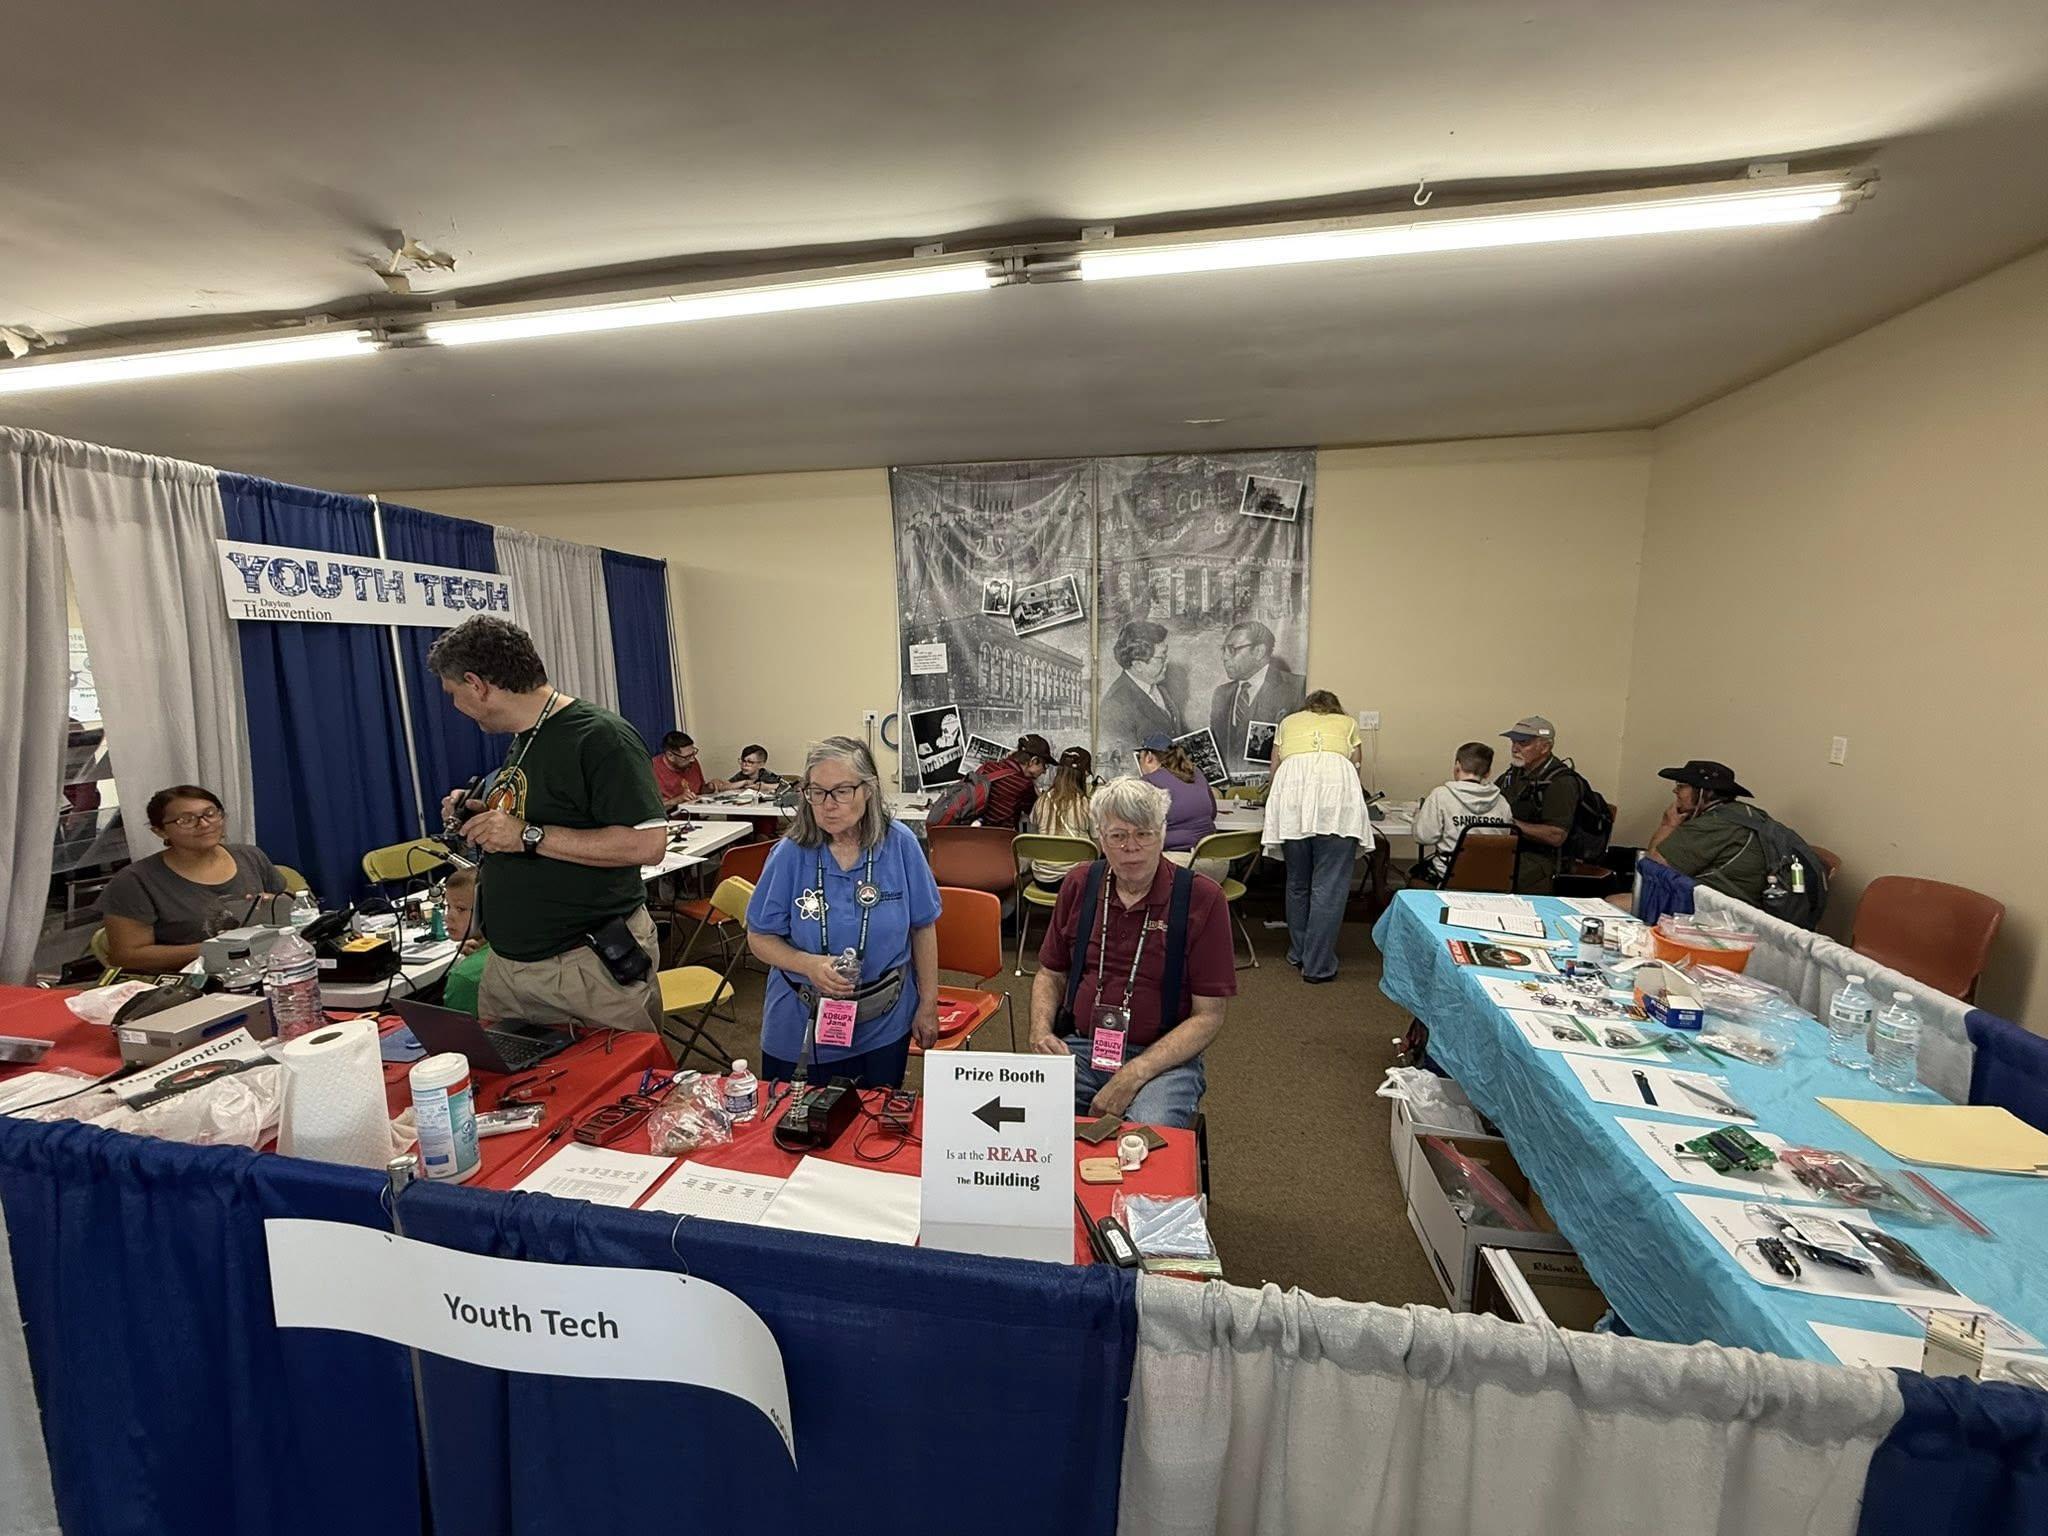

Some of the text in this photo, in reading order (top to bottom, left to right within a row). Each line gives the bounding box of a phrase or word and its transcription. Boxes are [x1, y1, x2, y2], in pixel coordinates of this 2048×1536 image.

[226, 551, 510, 612] YOUTH TECH
[244, 602, 332, 621] Hamvention
[260, 598, 291, 608] Dayton
[1452, 815, 1505, 827] SANDERSO
[954, 1066, 1045, 1083] Prize Booth
[946, 1146, 1053, 1164] Is at the REAR of
[956, 1171, 1041, 1192] The Building
[443, 1292, 619, 1340] Youth Tech
